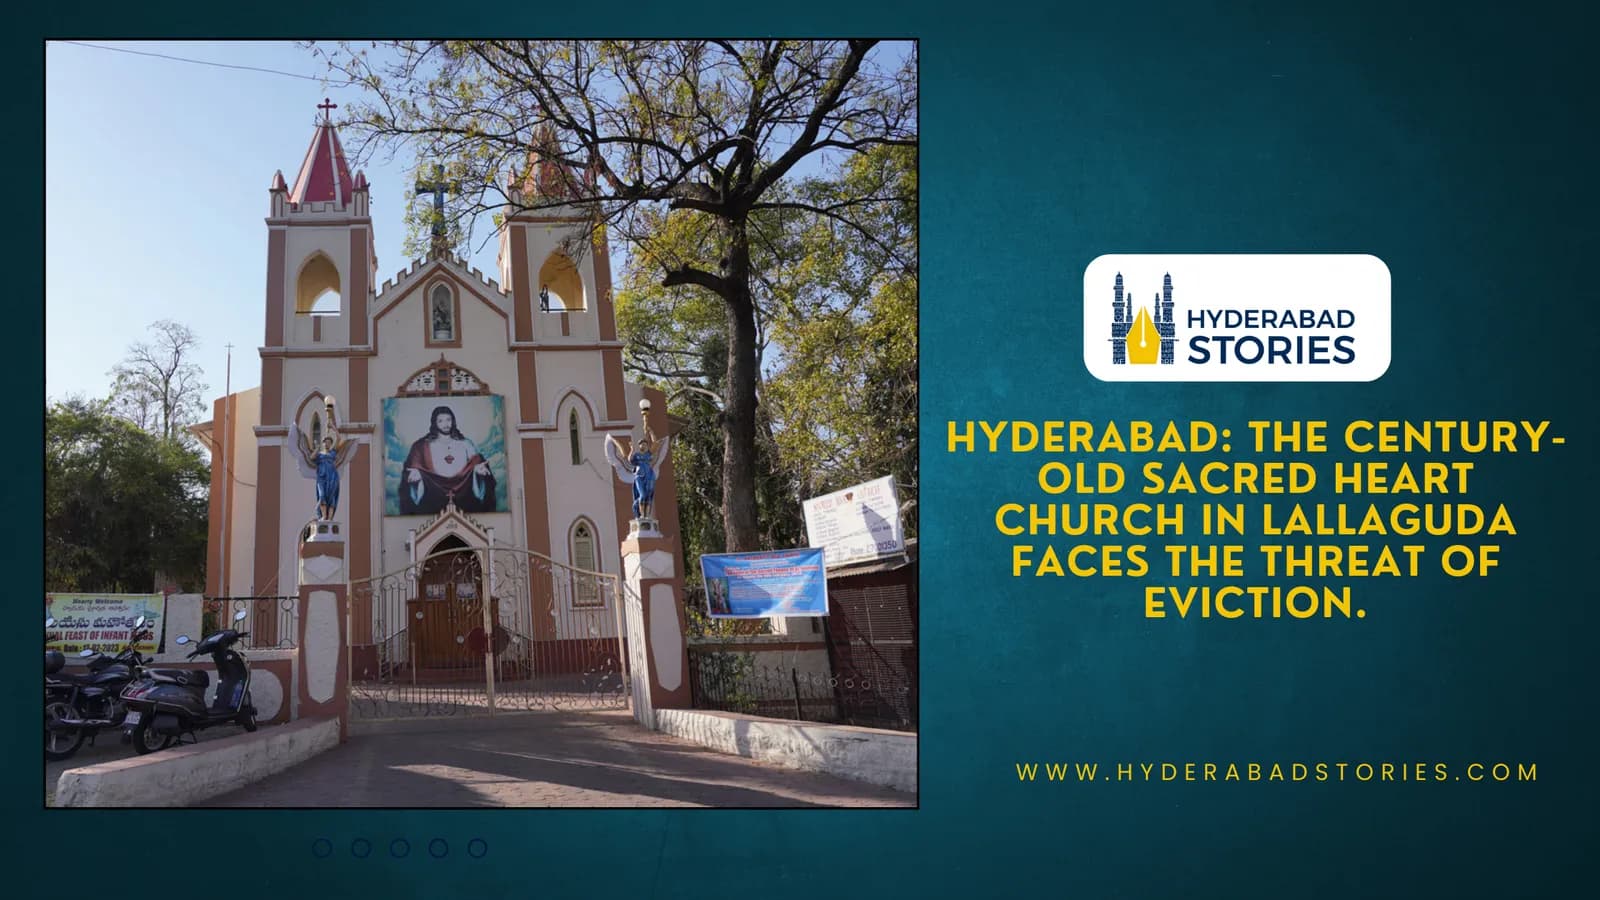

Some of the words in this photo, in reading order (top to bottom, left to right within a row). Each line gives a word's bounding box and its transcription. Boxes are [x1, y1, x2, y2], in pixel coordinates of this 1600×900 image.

[65, 631, 89, 641] FEAST
[89, 631, 101, 641] OF
[101, 631, 129, 641] INFANT
